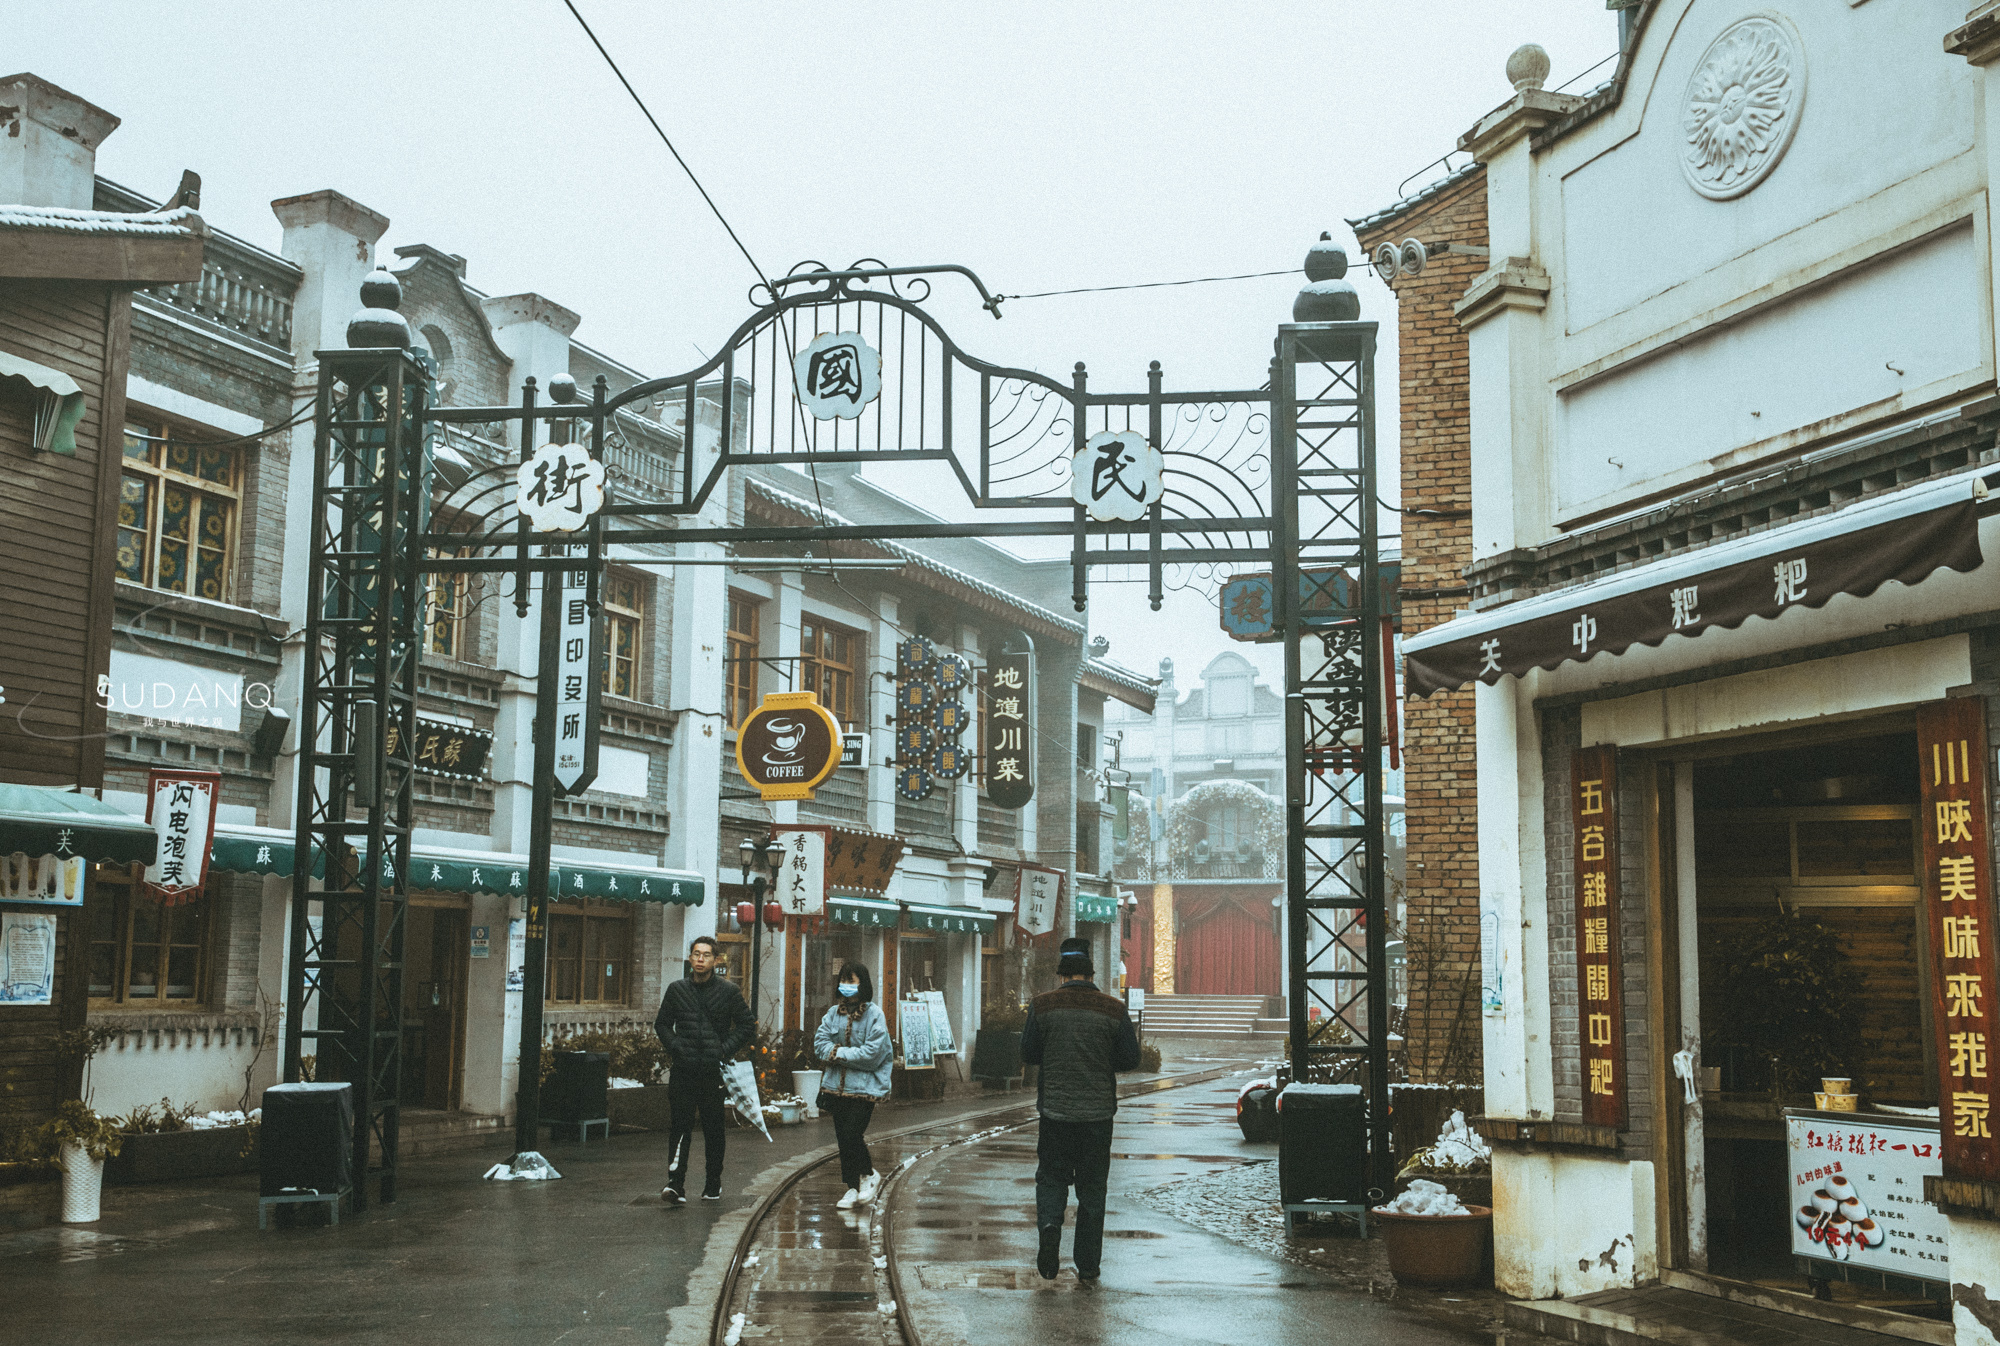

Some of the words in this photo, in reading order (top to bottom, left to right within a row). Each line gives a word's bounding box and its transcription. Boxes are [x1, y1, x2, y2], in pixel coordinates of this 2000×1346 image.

[993, 666, 1024, 782] 地道川菜
[766, 765, 804, 778] COFFEE
[57, 828, 75, 855] 芙
[161, 784, 195, 886] 闪电泡芙
[791, 833, 808, 913] 香锅大虾
[1027, 875, 1048, 926] 地道川菜
[1796, 1161, 1843, 1186] 儿时的味道
